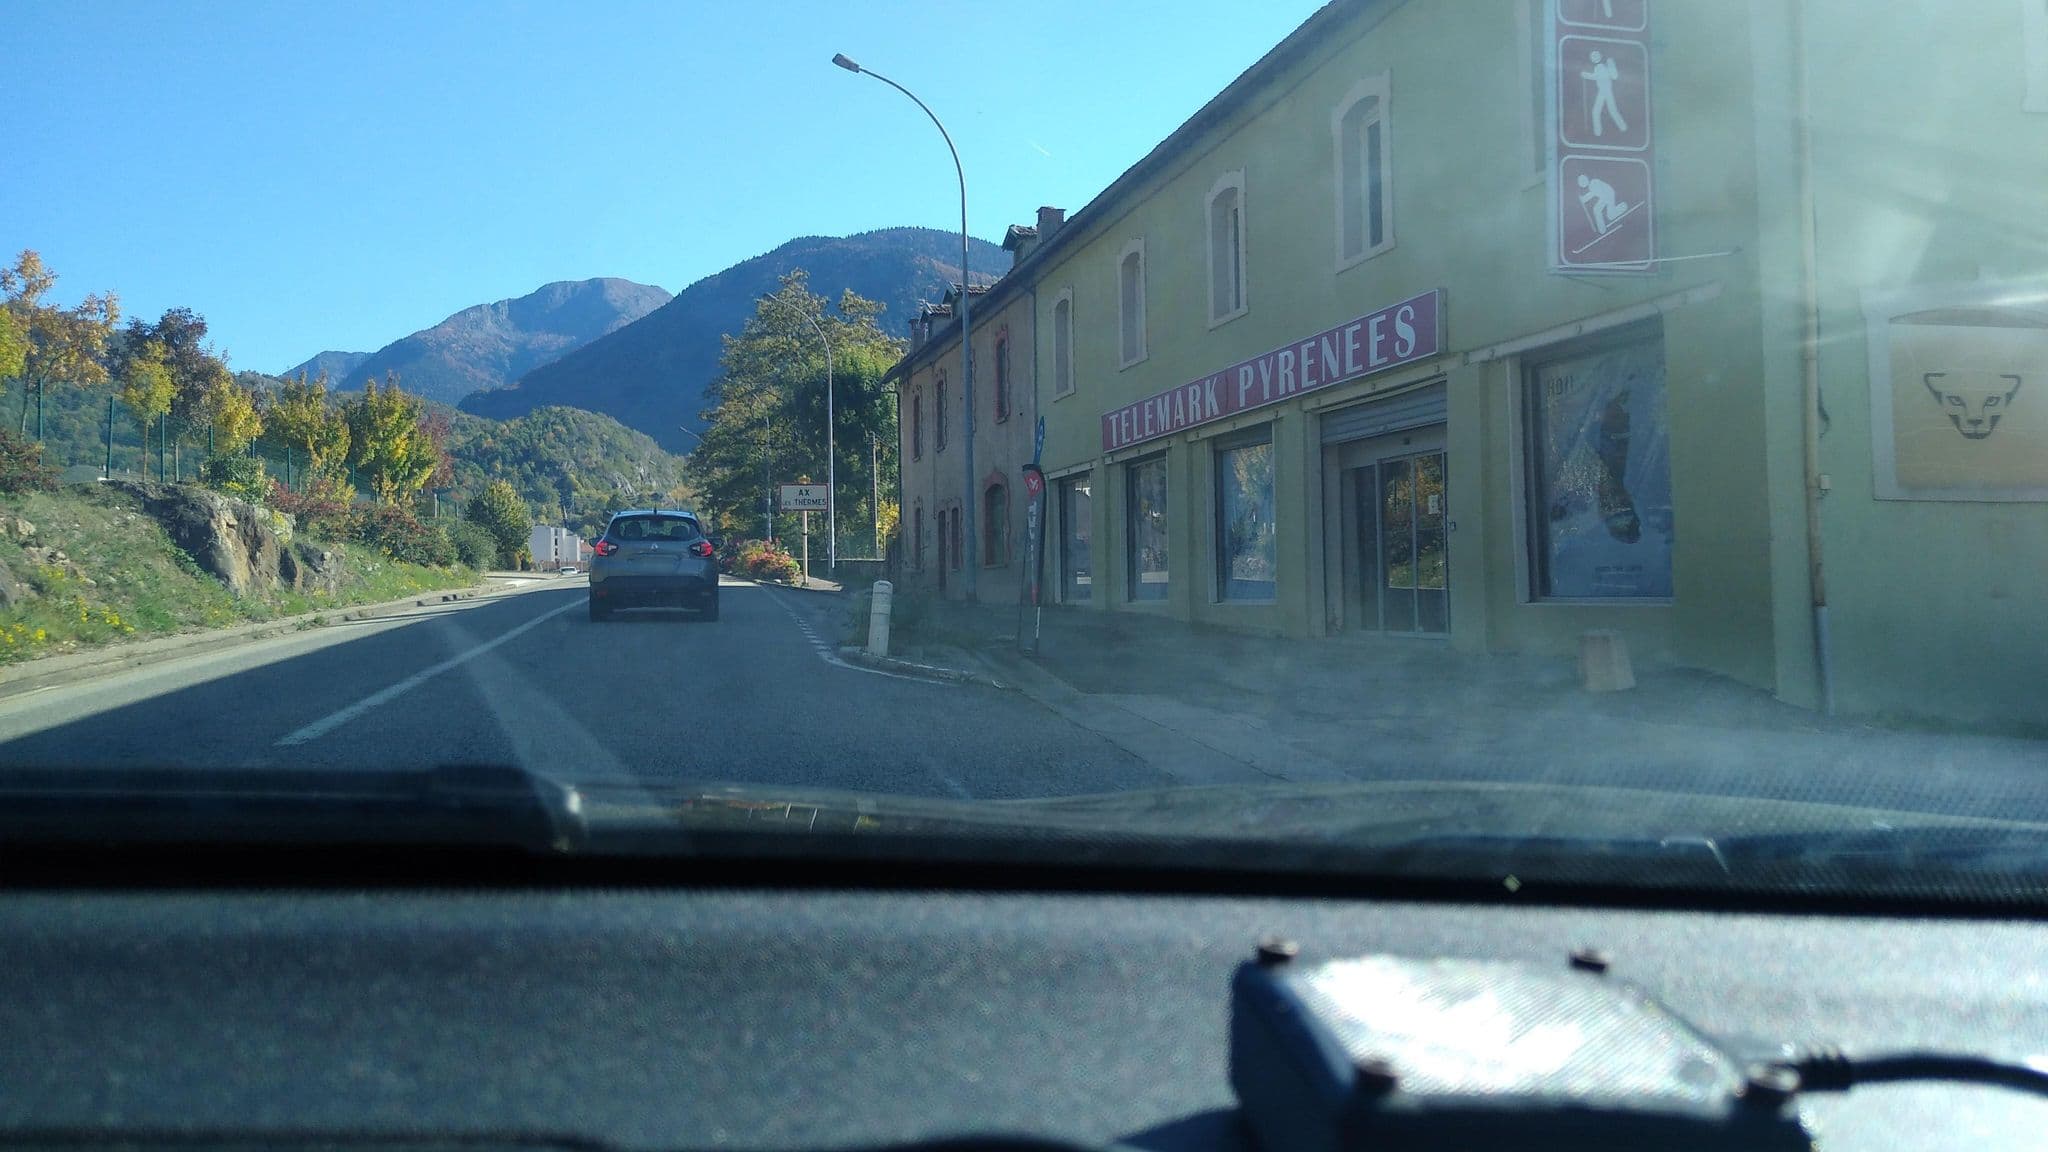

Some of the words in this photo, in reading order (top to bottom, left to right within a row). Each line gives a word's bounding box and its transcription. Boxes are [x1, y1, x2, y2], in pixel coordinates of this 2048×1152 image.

[1108, 376, 1220, 447] TELEMARK
[1238, 304, 1417, 408] PYRENEES
[794, 498, 827, 506] THERMES
